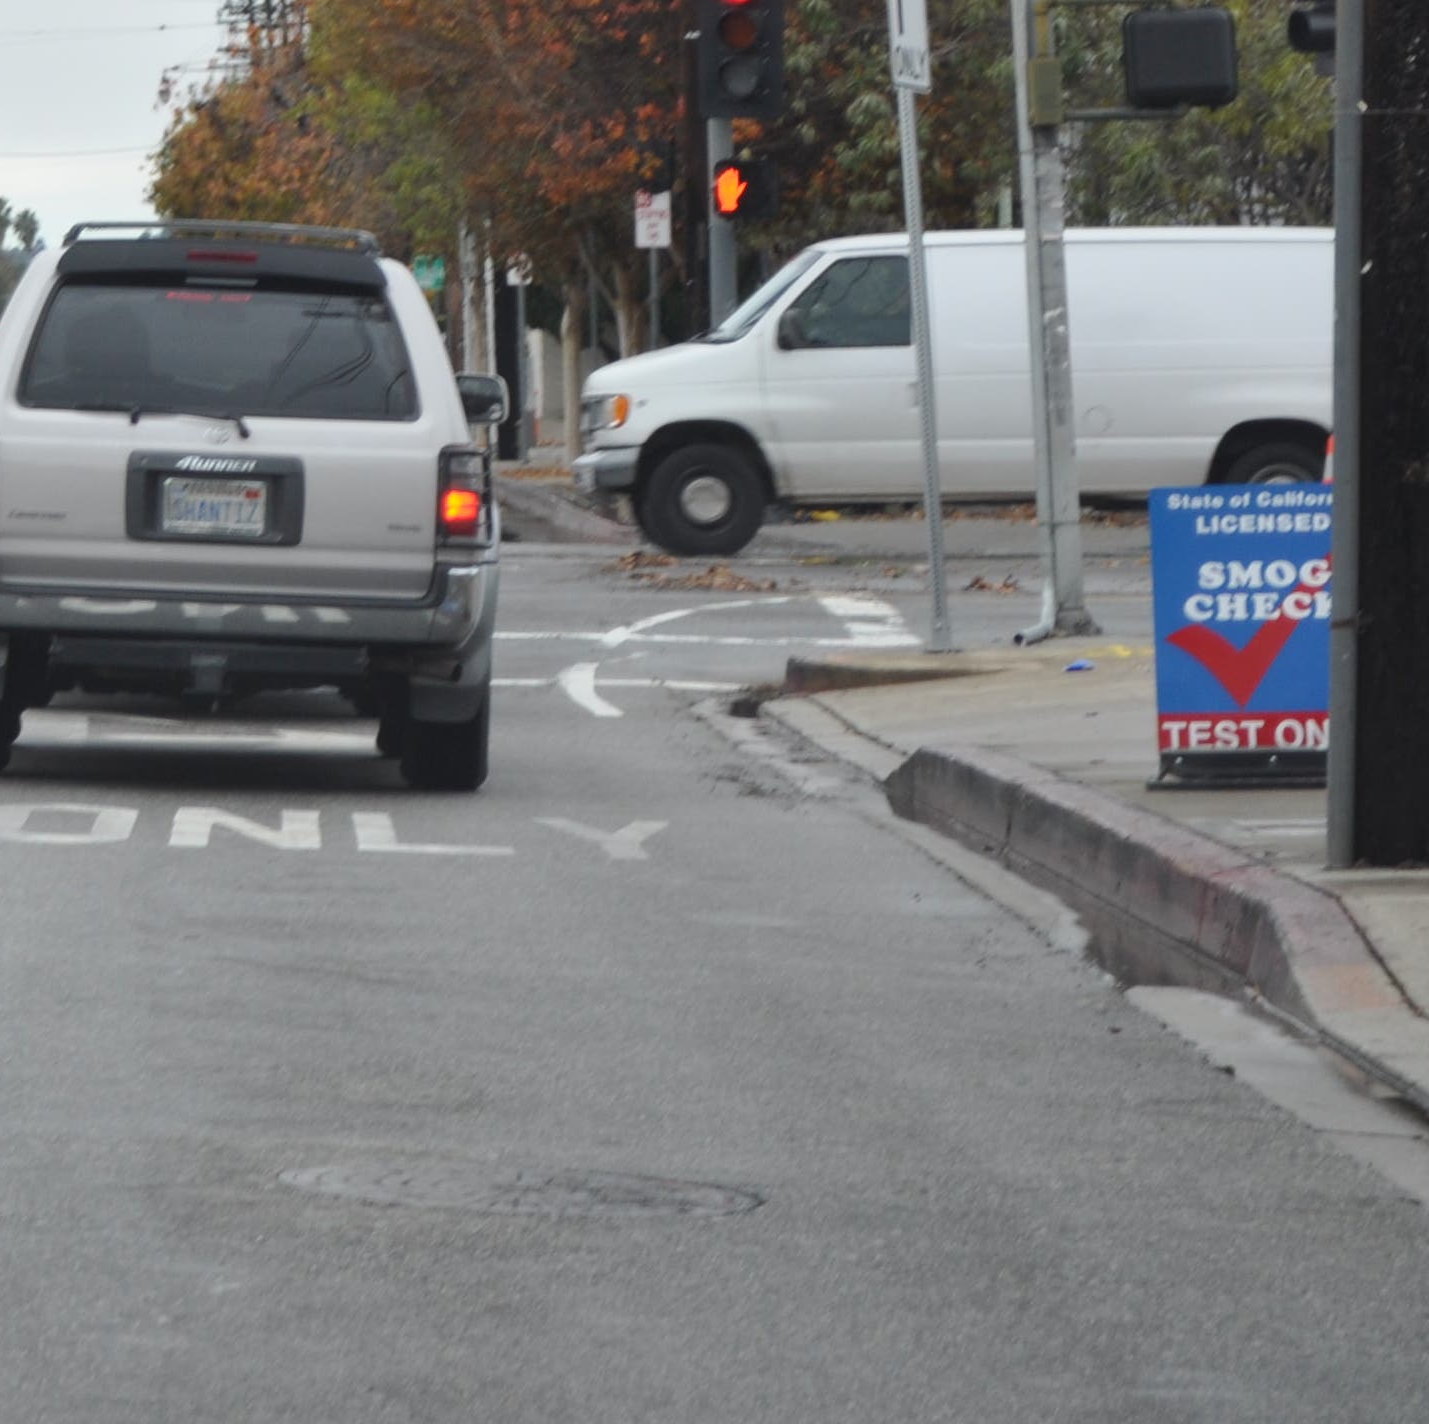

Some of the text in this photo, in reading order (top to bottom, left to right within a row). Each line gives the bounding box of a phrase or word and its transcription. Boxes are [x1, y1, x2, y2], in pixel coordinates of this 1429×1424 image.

[1166, 492, 1225, 511] State
[1229, 491, 1252, 509] of
[1196, 512, 1332, 535] LICENSED
[1198, 558, 1333, 590] SMOG
[1162, 717, 1330, 752] TEST ON
